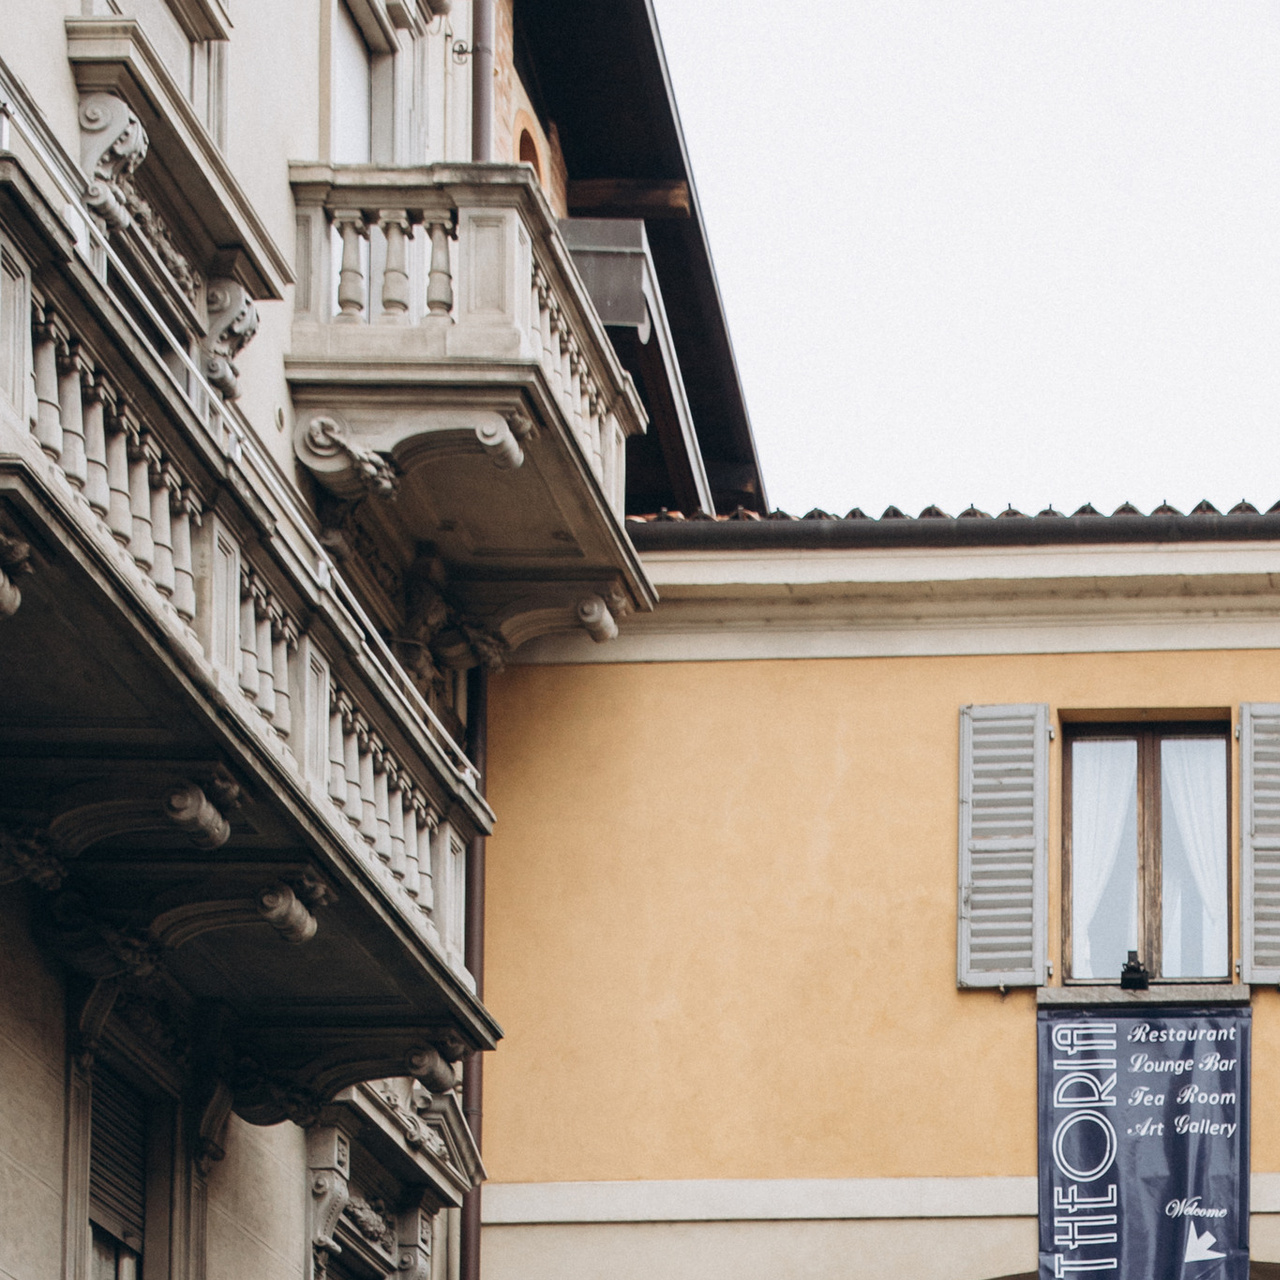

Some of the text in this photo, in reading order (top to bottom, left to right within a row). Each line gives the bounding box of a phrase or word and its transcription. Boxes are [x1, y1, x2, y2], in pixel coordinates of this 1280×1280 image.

[1127, 1023, 1236, 1042] Restaurant
[1128, 1052, 1236, 1075] Lounge Bar
[1128, 1083, 1236, 1106] Tea Room
[1127, 1114, 1237, 1138] Art Gallery
[1052, 1023, 1118, 1279] THEORIA
[1165, 1196, 1228, 1218] Welcome
